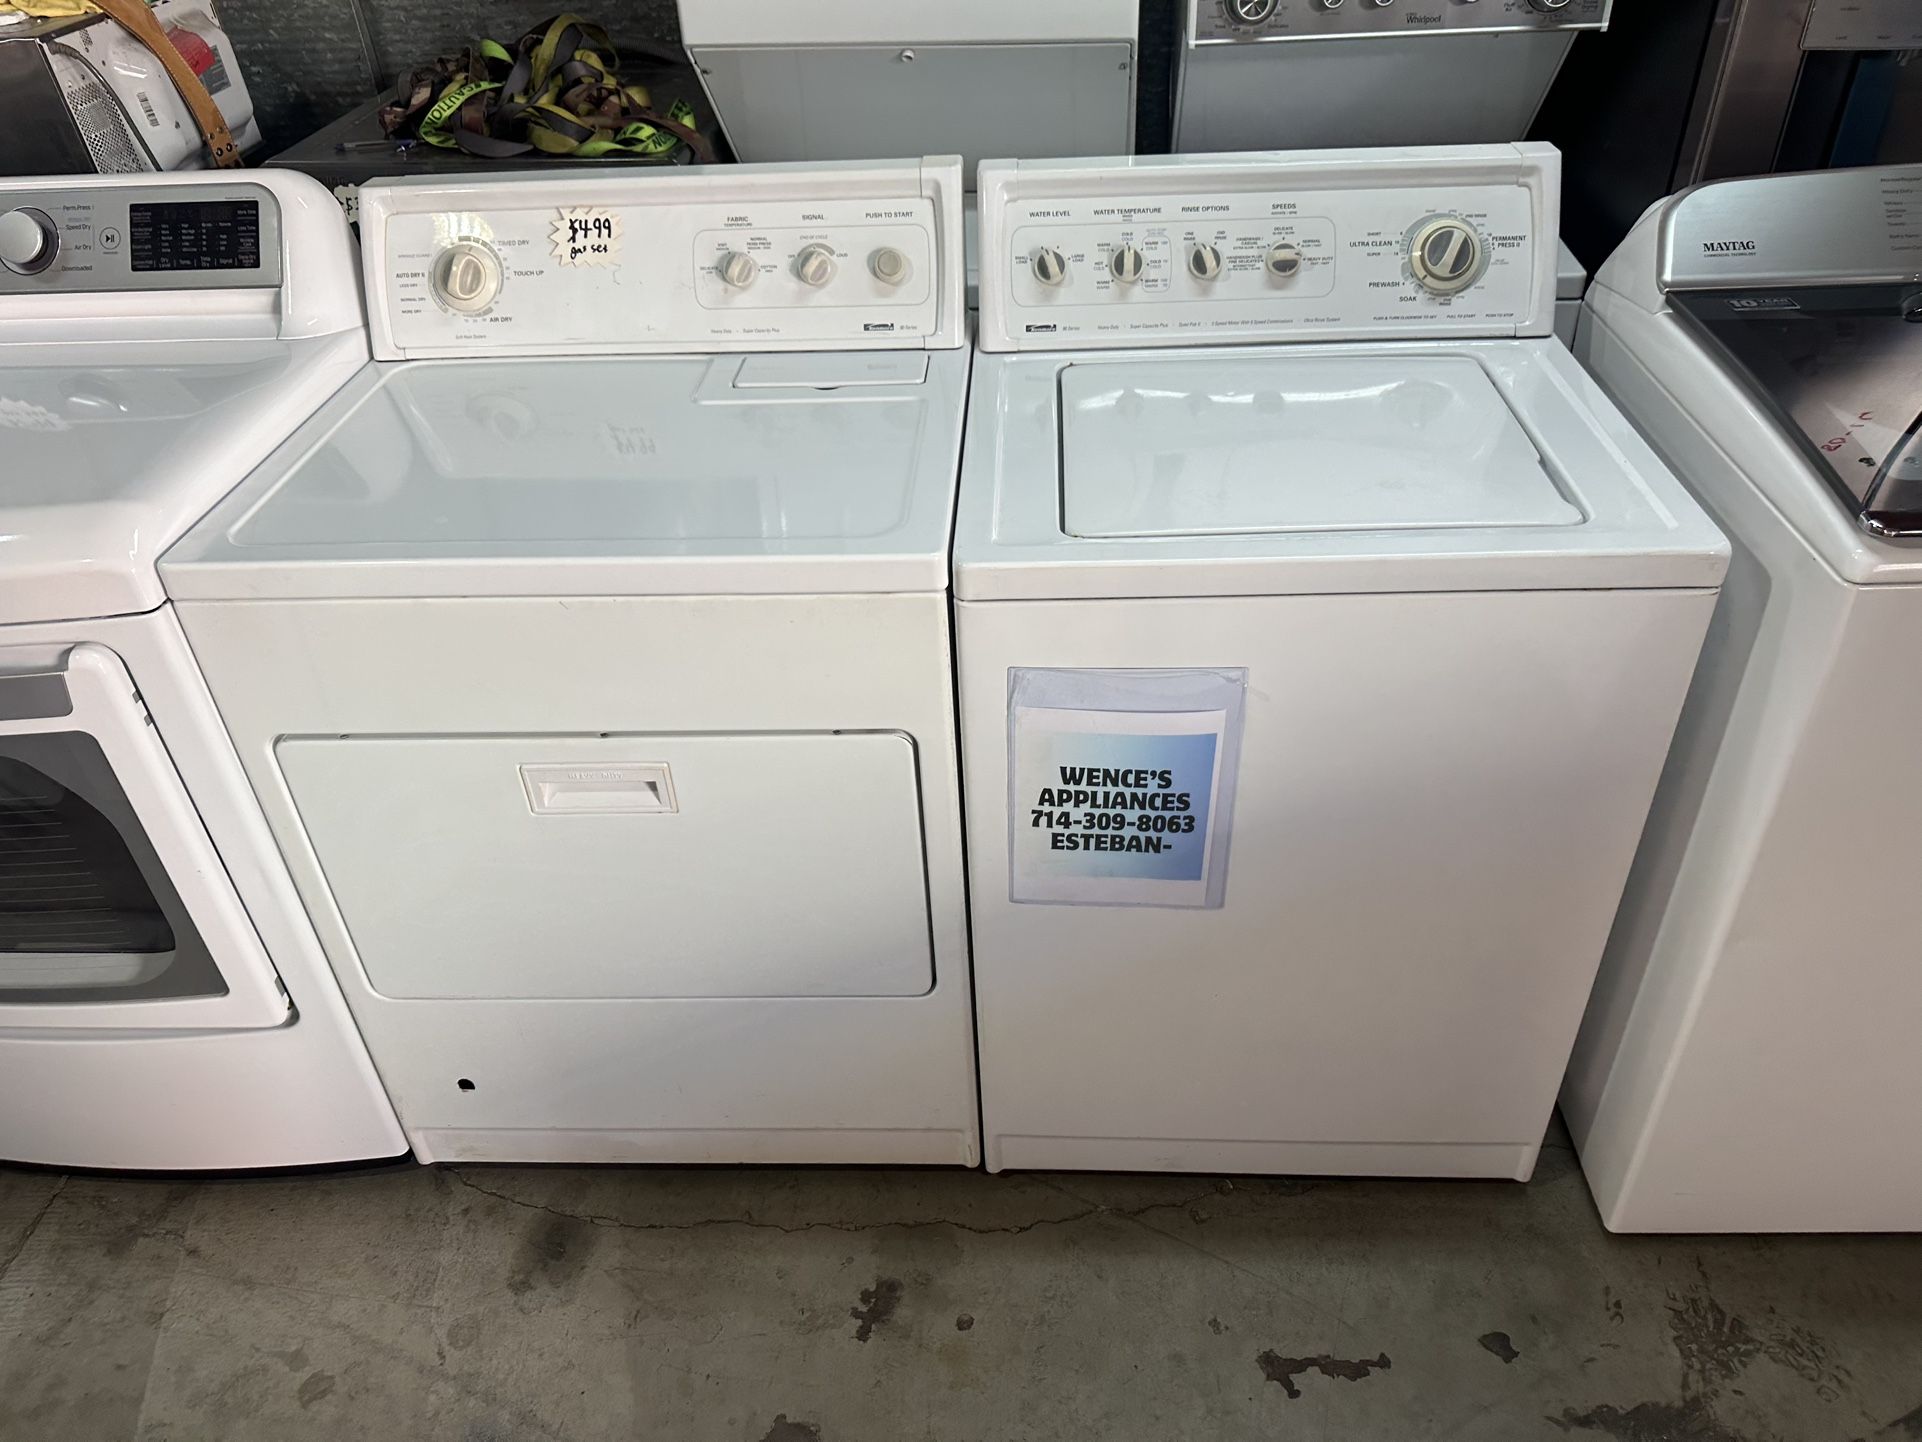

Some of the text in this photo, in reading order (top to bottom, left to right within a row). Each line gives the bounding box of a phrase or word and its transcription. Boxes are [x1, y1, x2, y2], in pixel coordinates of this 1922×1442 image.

[1406, 14, 1442, 24] Whirlpool
[1703, 241, 1755, 252] MAYTAG
[1059, 766, 1172, 788] WENCE'S
[1038, 788, 1190, 812] APPLIANCES
[1031, 810, 1196, 833] 714-309-8063
[1050, 832, 1172, 854] ESTEBAN-
